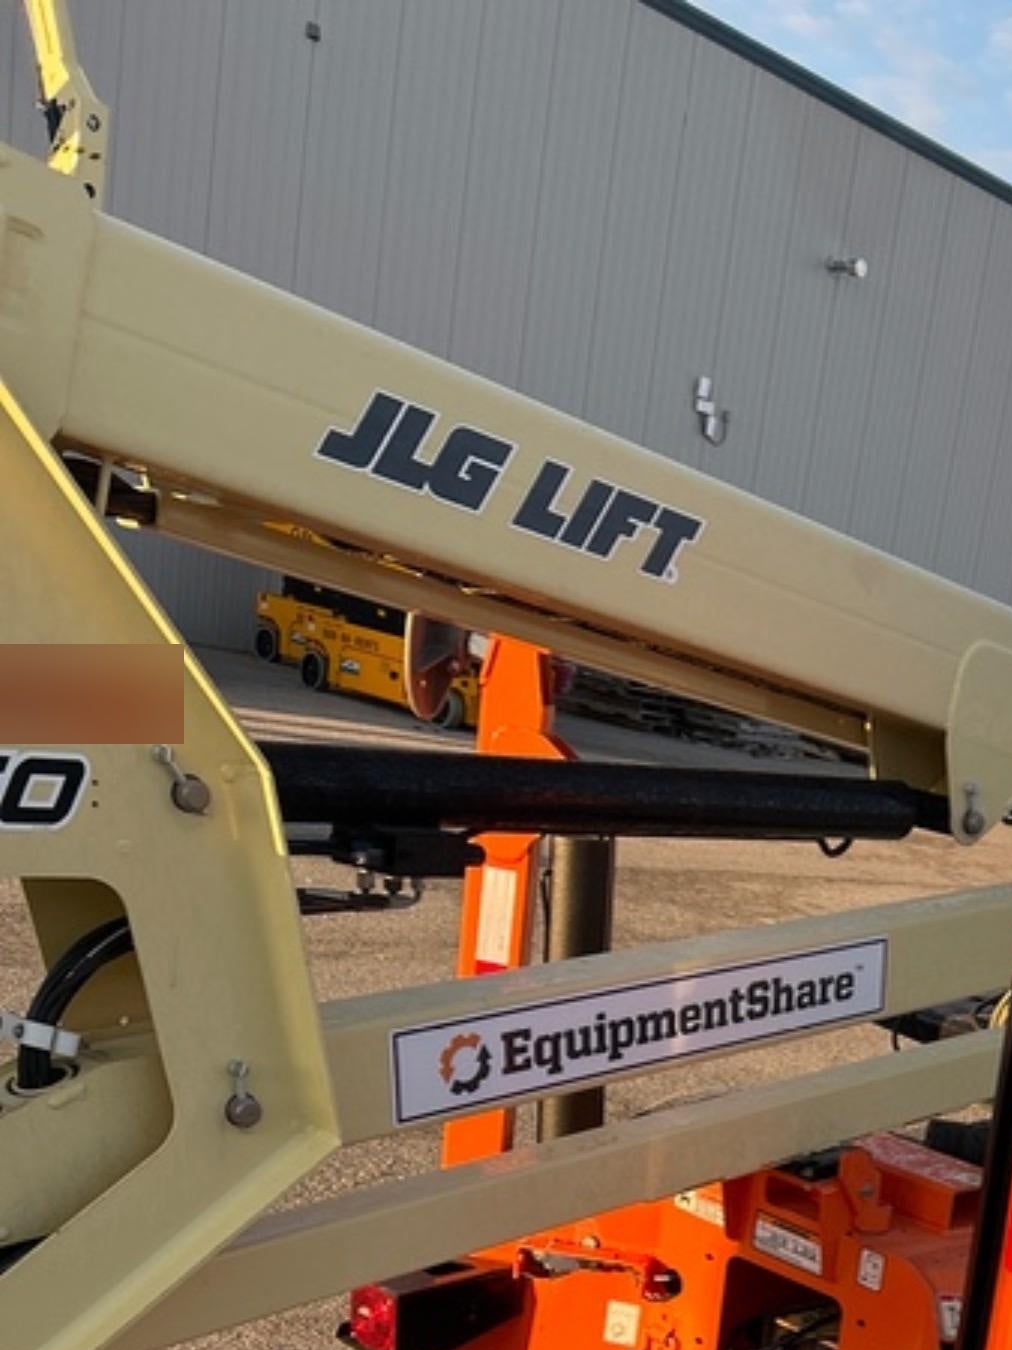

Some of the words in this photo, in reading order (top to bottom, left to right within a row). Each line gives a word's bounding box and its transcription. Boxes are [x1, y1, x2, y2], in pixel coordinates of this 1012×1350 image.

[316, 390, 515, 511] JLG
[511, 460, 703, 578] LIFT
[500, 970, 855, 1076] EquipmentShare
